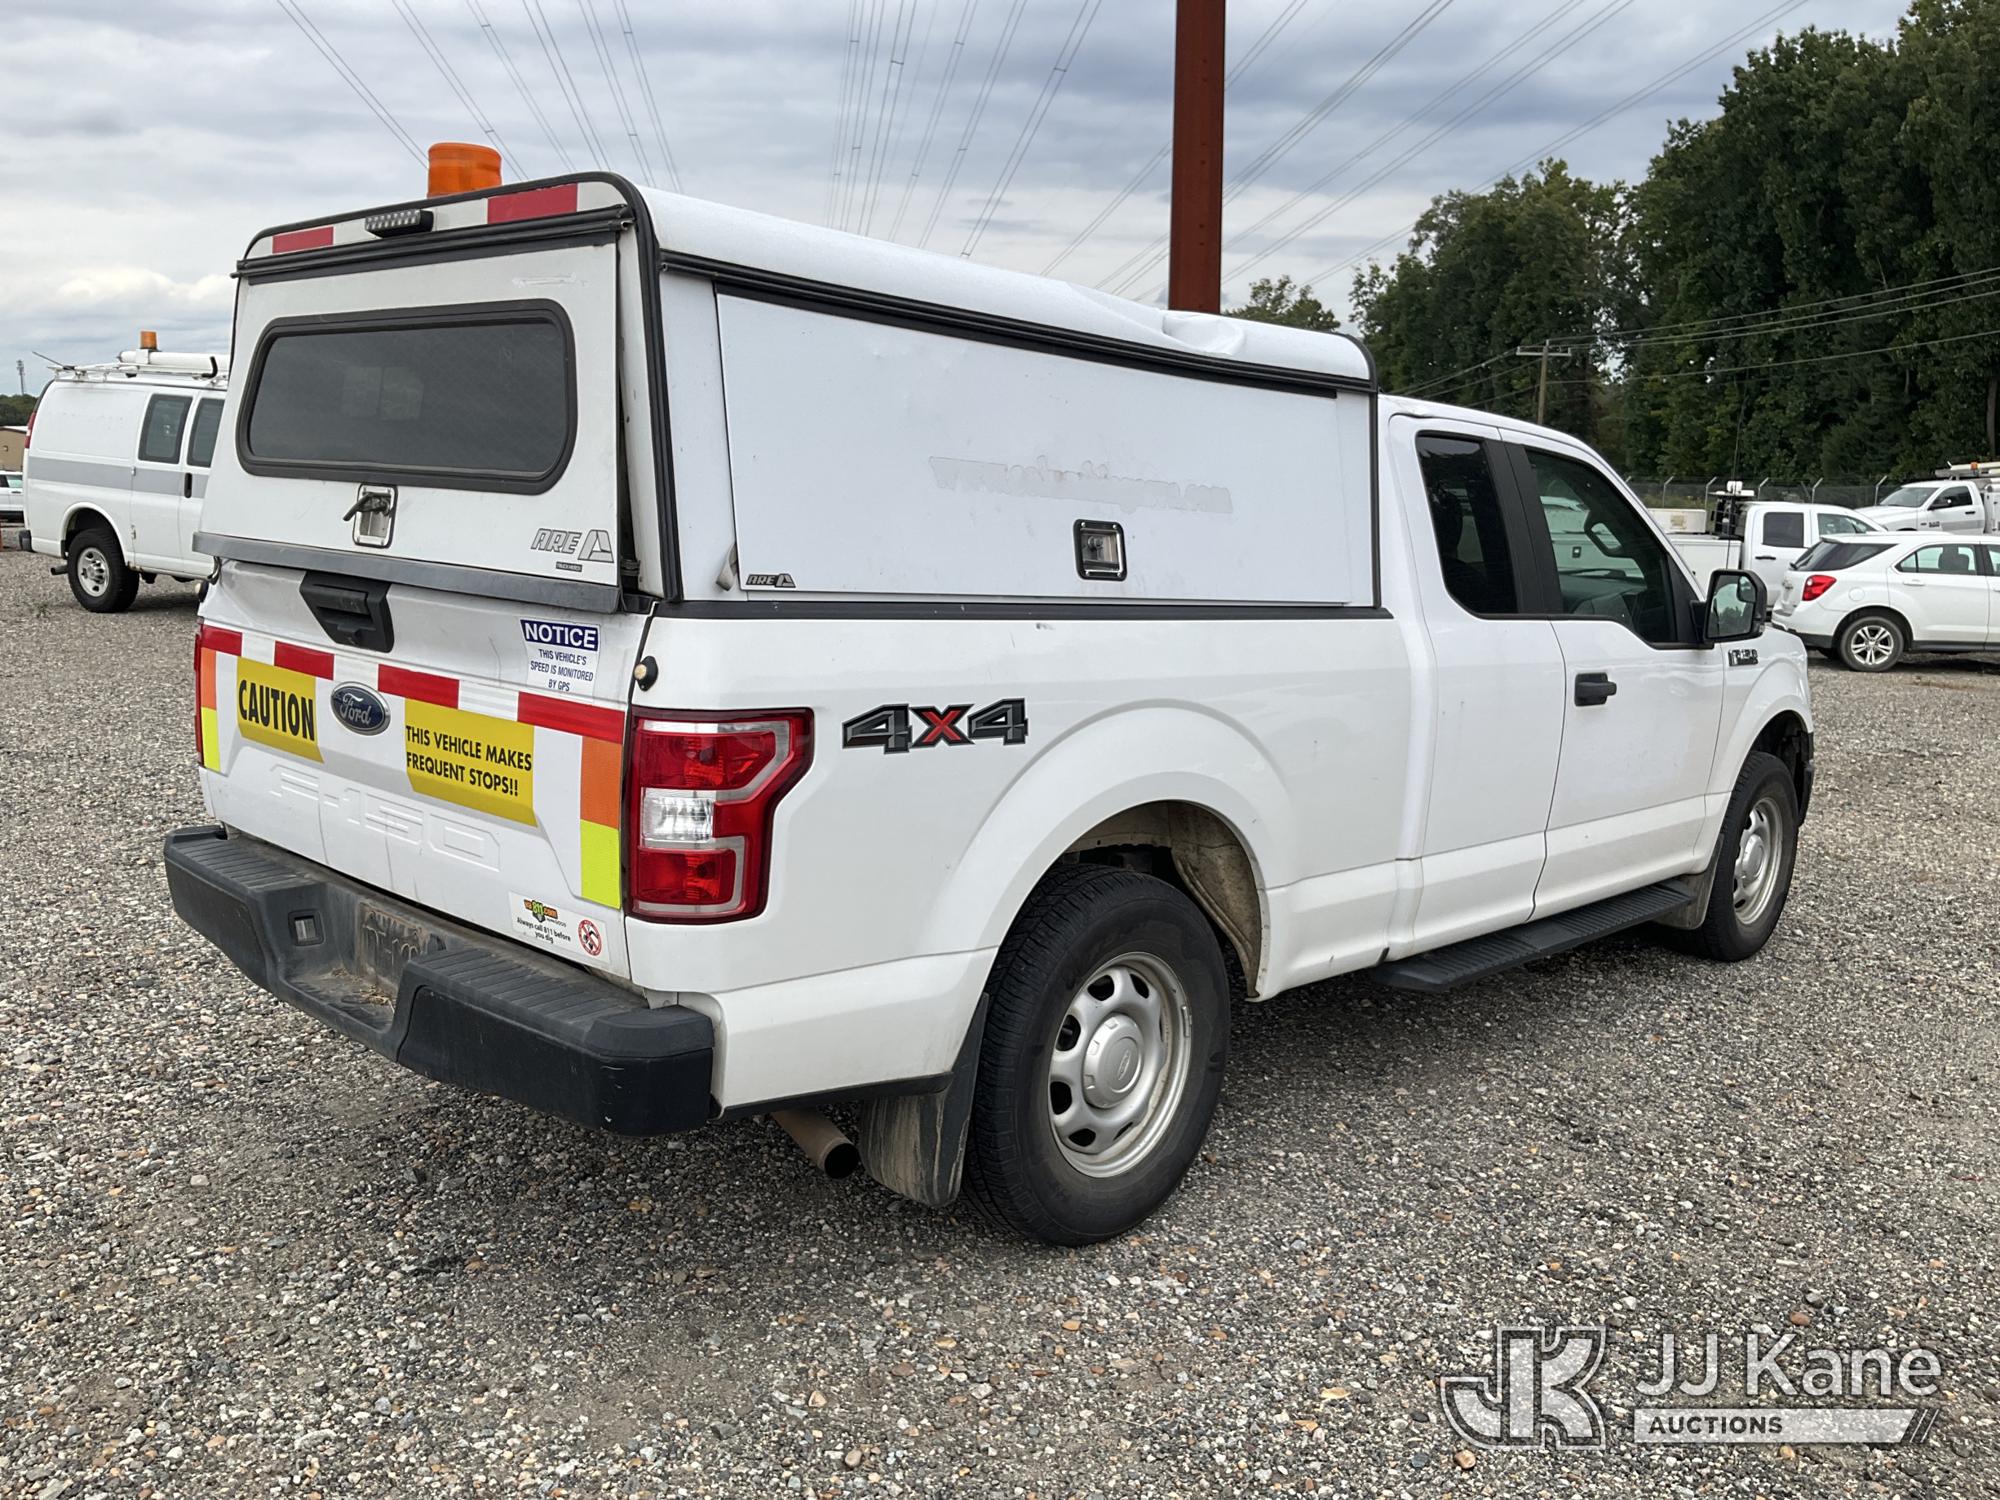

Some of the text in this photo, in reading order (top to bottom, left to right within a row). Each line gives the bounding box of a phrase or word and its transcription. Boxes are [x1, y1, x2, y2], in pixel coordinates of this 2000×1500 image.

[524, 622, 597, 649] NOTICE
[538, 648, 587, 666] THIS VEHICLE'S
[530, 660, 594, 682] SPEED IS MONITORED
[548, 679, 570, 692] BY GPS
[238, 679, 315, 741] CAUTION
[339, 692, 372, 725] Ford
[405, 725, 532, 771] THIS VEHICLE MAKES
[406, 751, 518, 796] FREQUENT STOPS!!
[517, 916, 534, 929] Always
[534, 923, 544, 932] call
[543, 926, 554, 936] 811
[554, 930, 571, 942] before
[535, 931, 554, 944] you dig
